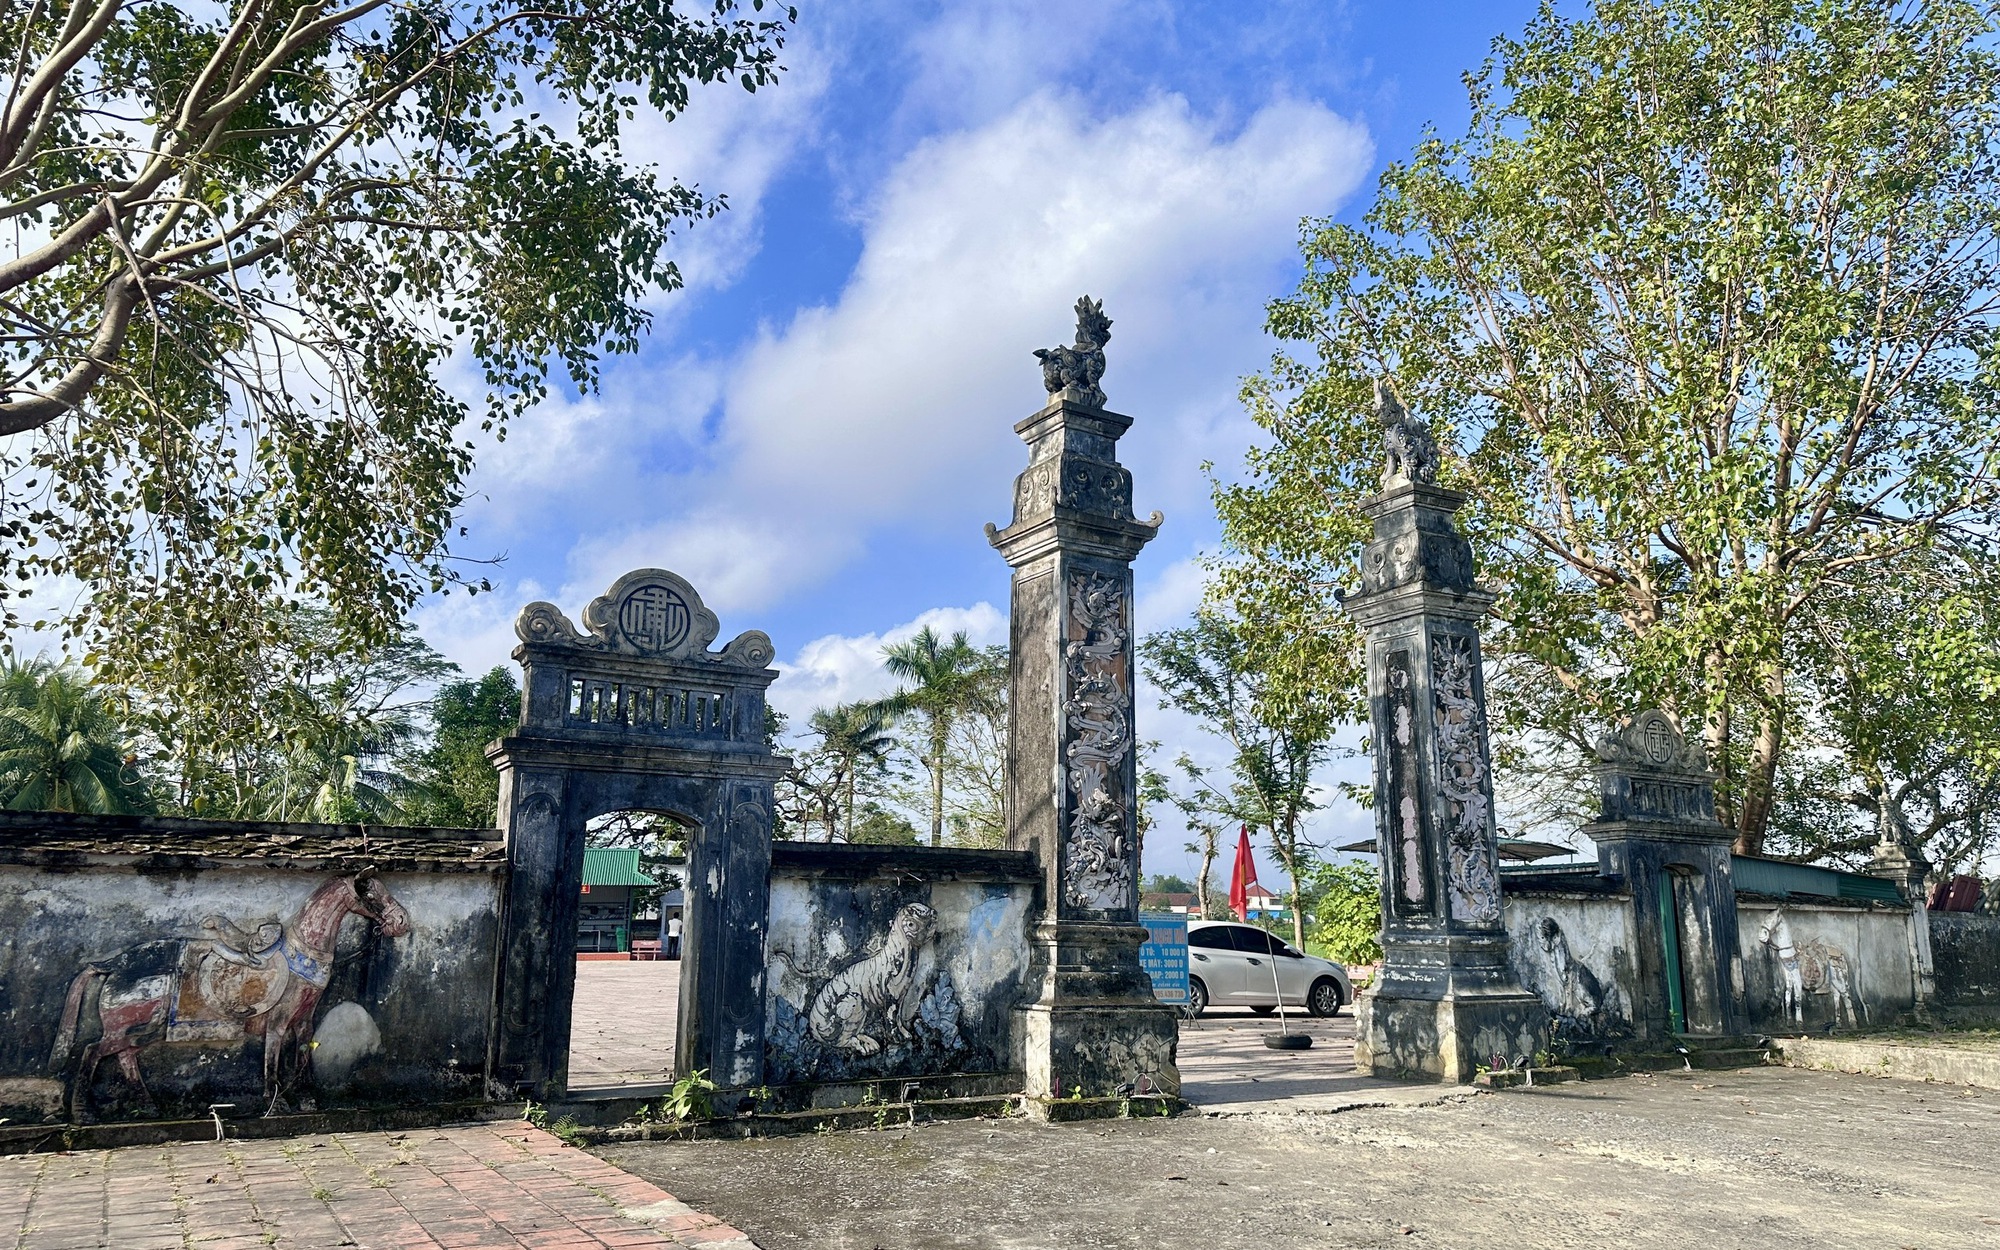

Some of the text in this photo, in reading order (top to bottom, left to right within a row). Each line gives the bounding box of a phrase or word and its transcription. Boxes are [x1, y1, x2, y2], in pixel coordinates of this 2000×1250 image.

[1162, 948, 1169, 956] 10
[1163, 959, 1178, 968] 3000
[1165, 971, 1179, 979] 2000
